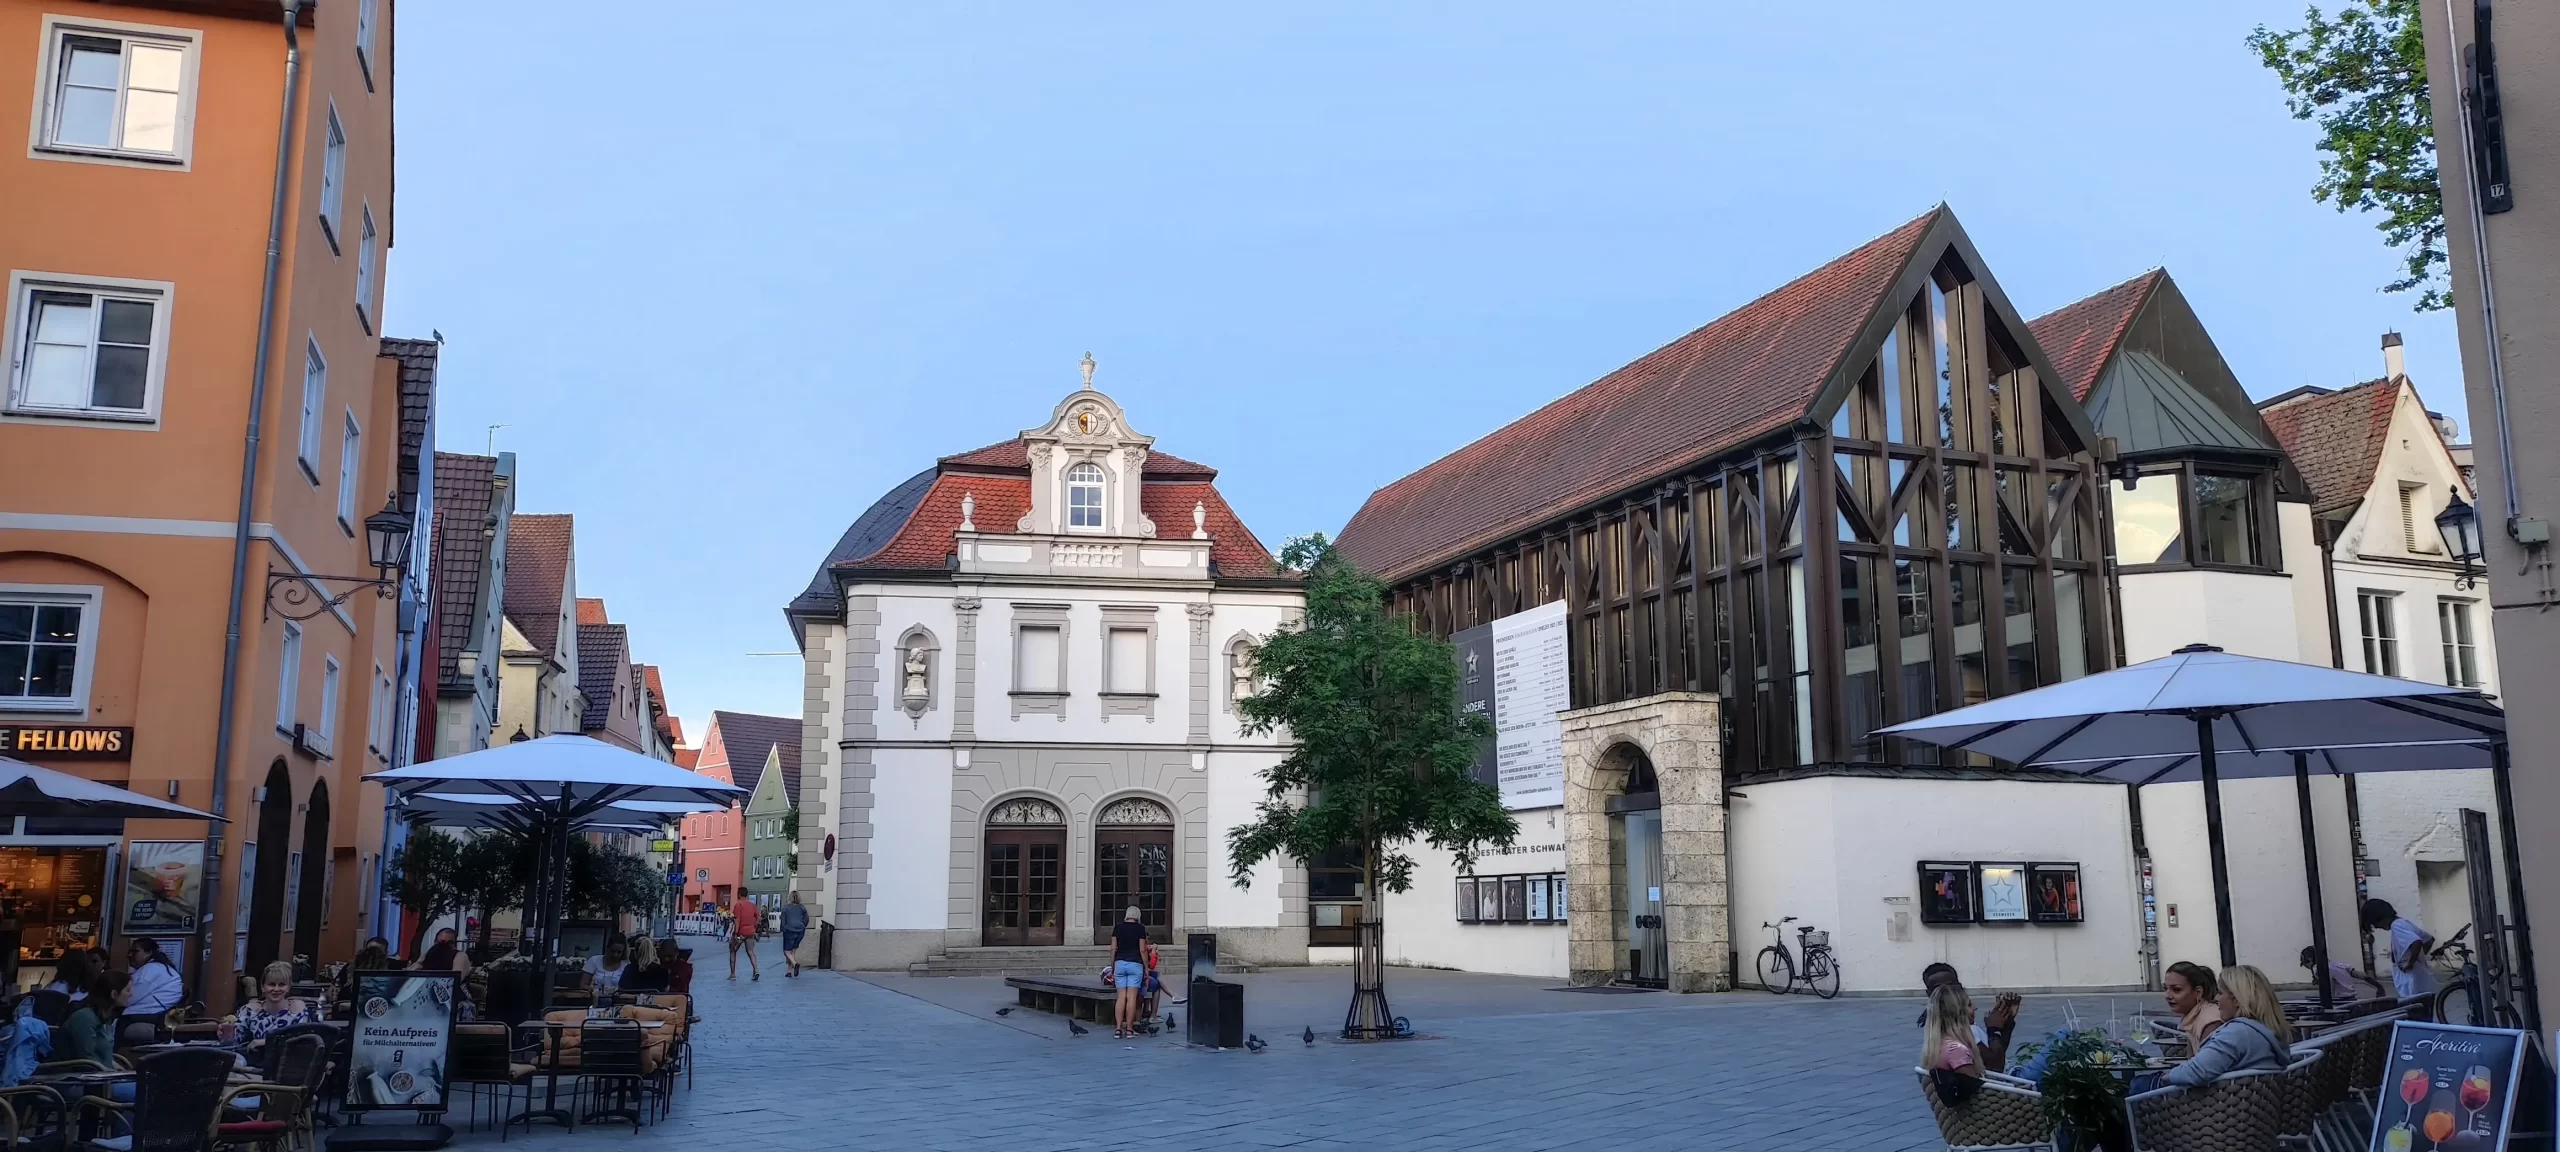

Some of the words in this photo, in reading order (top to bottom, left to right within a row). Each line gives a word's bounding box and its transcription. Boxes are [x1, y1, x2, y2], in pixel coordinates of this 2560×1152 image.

[2491, 184, 2503, 196] 17
[17, 729, 122, 752] FELLOWS
[1463, 846, 1527, 858] NDESTHEATER
[364, 1027, 389, 1037] Kein
[390, 1027, 438, 1039] Aufpreis
[374, 1040, 437, 1048] Milchalternativen!
[2416, 1033, 2481, 1055] Aperitivi
